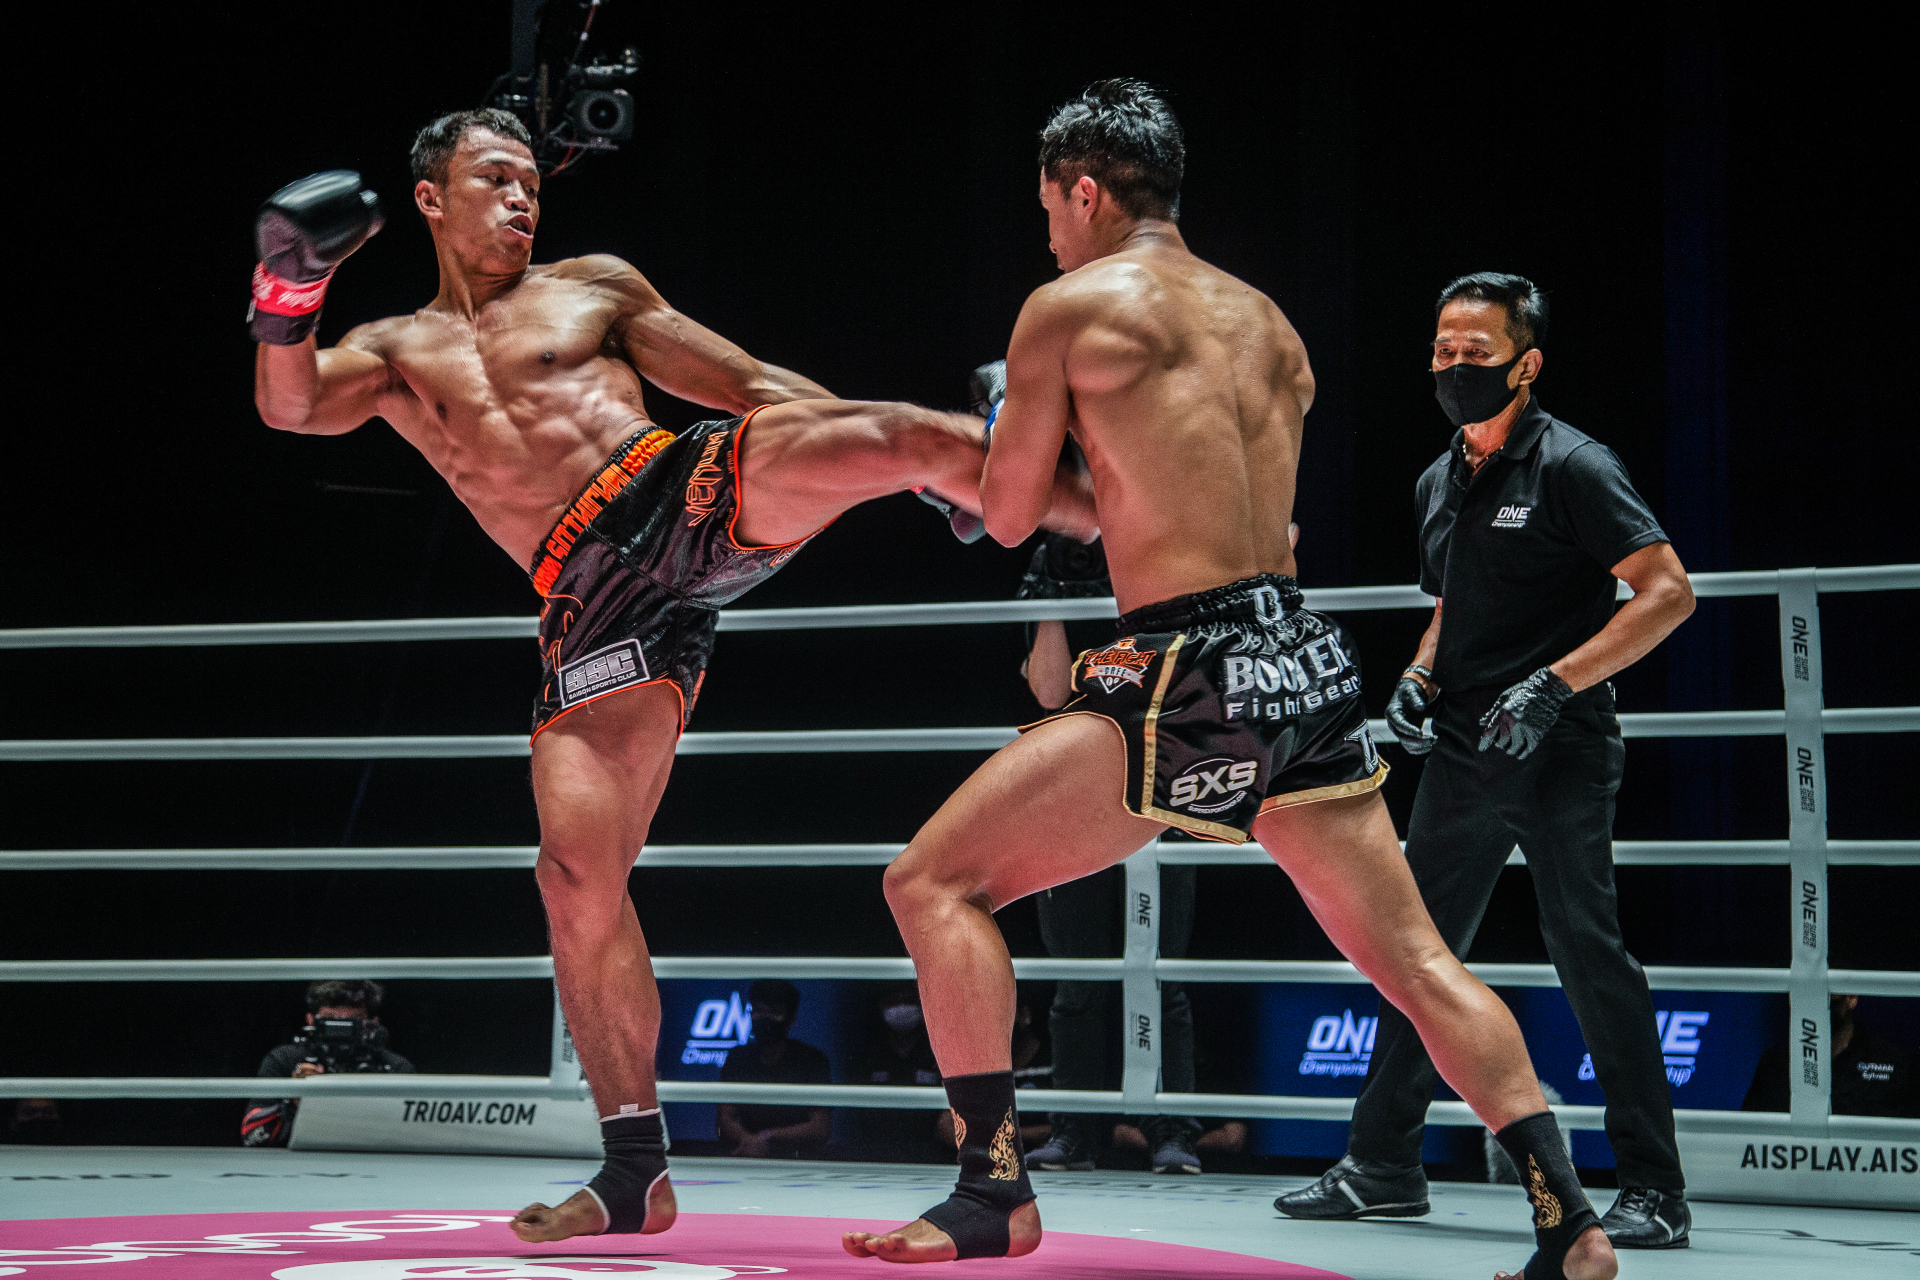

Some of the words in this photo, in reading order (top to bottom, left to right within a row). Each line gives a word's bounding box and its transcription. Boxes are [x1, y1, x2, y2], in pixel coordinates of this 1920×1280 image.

[686, 430, 728, 527] VENUM
[1496, 504, 1531, 522] ONE
[1791, 615, 1810, 657] ONE
[565, 648, 636, 693] SSC
[568, 687, 591, 700] SAIGON
[591, 678, 617, 691] SPORTS
[617, 670, 638, 682] CLUB
[1169, 760, 1258, 807] SXS
[1796, 746, 1815, 788] ONE
[1137, 892, 1152, 928] ONE
[1801, 880, 1819, 923] ONE
[690, 991, 753, 1046] ON
[1137, 1014, 1152, 1051] ONE
[1799, 1017, 1819, 1061] ONE
[403, 1100, 537, 1125] TRIOAV.COM
[1741, 1143, 1918, 1173] AISPLAY.AIS
